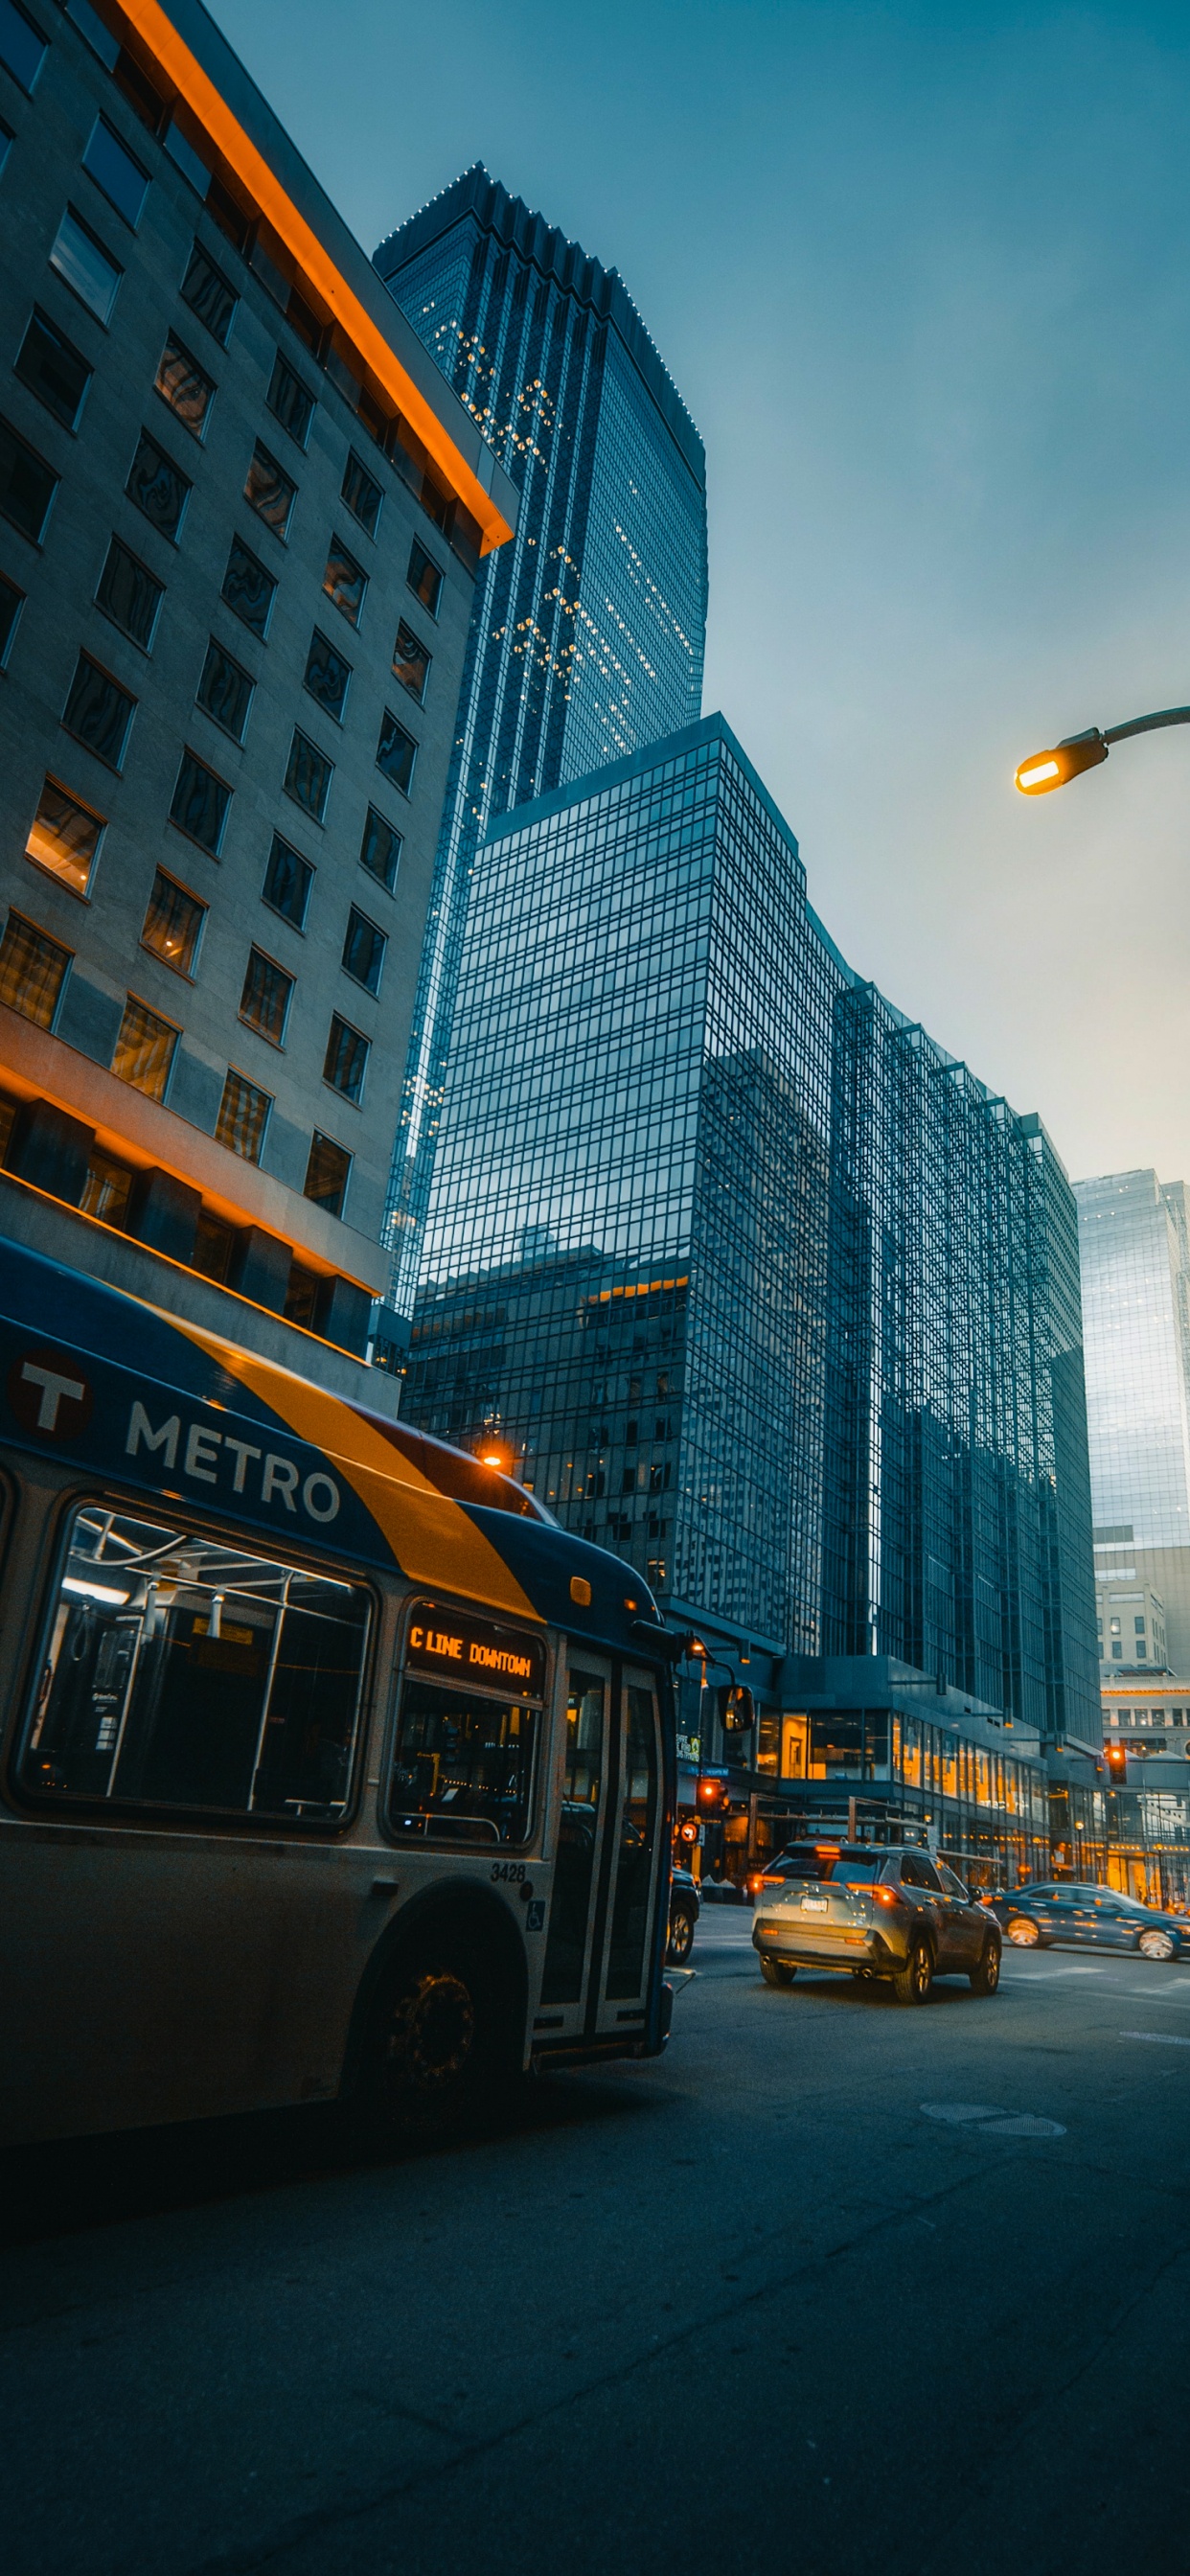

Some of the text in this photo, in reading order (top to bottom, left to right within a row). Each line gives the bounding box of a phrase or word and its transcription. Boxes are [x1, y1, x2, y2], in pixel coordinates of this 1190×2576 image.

[21, 1362, 340, 1523] T METRO
[410, 1627, 531, 1678] C LINE DOWNTOWN
[491, 1863, 526, 1883] 3428
